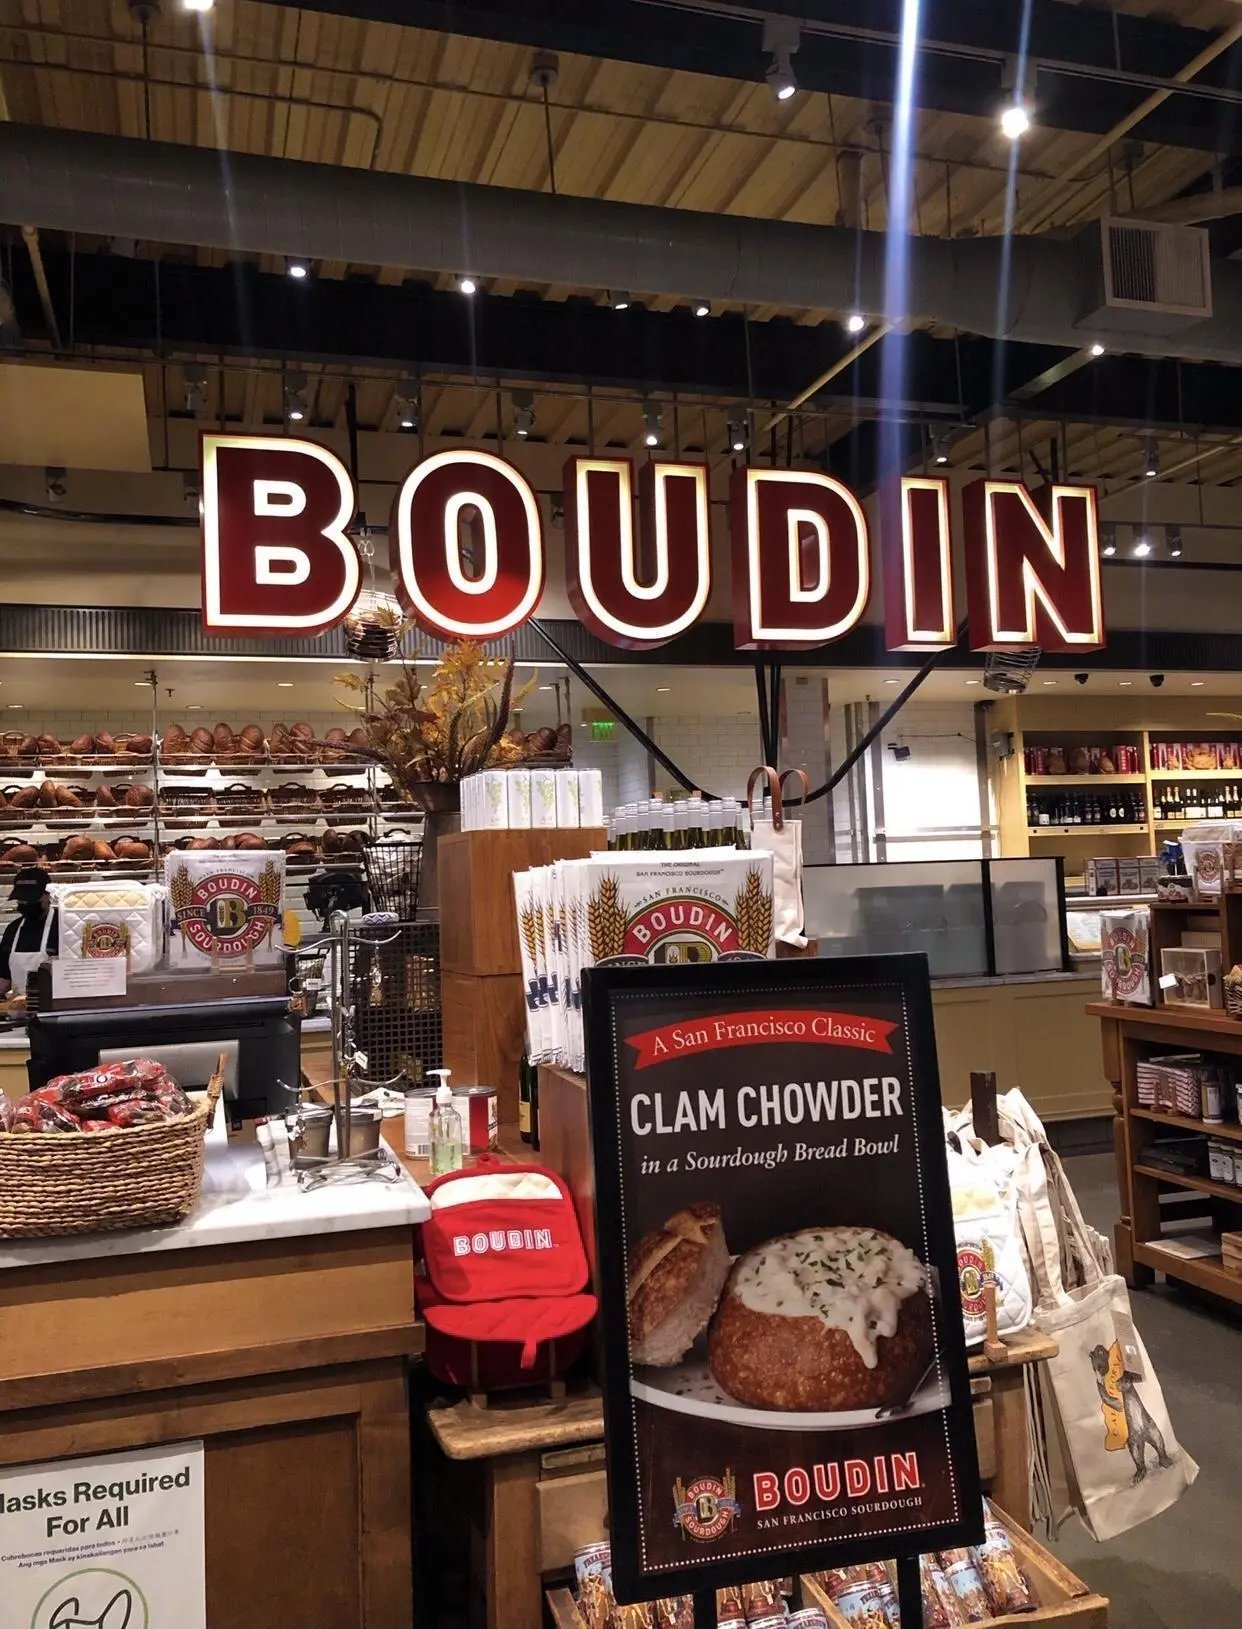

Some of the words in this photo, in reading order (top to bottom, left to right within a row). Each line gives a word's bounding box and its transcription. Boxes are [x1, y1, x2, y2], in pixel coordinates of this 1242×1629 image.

[200, 432, 1106, 653] BOUDIN
[197, 878, 258, 900] BOUDIN
[643, 890, 661, 902] SAN
[666, 887, 722, 901] FRANCISCO
[177, 908, 206, 919] SINCE
[253, 906, 275, 915] 1849
[632, 906, 733, 944] BOUDIN
[652, 1036, 669, 1056] A
[672, 1030, 709, 1047] San
[713, 1016, 806, 1042] Francisco
[811, 1017, 876, 1043] Classic
[630, 1088, 726, 1136] CLAM
[737, 1076, 904, 1128] CHOWDER
[640, 1155, 661, 1175] in
[667, 1157, 679, 1172] a
[685, 1144, 788, 1171] Sourdough
[794, 1138, 848, 1161] Bread
[854, 1134, 900, 1157] Bowl
[0, 1488, 67, 1513] asks
[73, 1466, 190, 1504] Required
[688, 1482, 723, 1499] BOUDIN
[753, 1451, 921, 1512] BOUDIN
[47, 1516, 90, 1538] For
[96, 1506, 129, 1531] All
[684, 1510, 729, 1536] SOURDOUGH
[757, 1518, 779, 1530] SAN
[783, 1507, 848, 1527] FRANCISCO
[851, 1496, 923, 1515] SOURDOUGH
